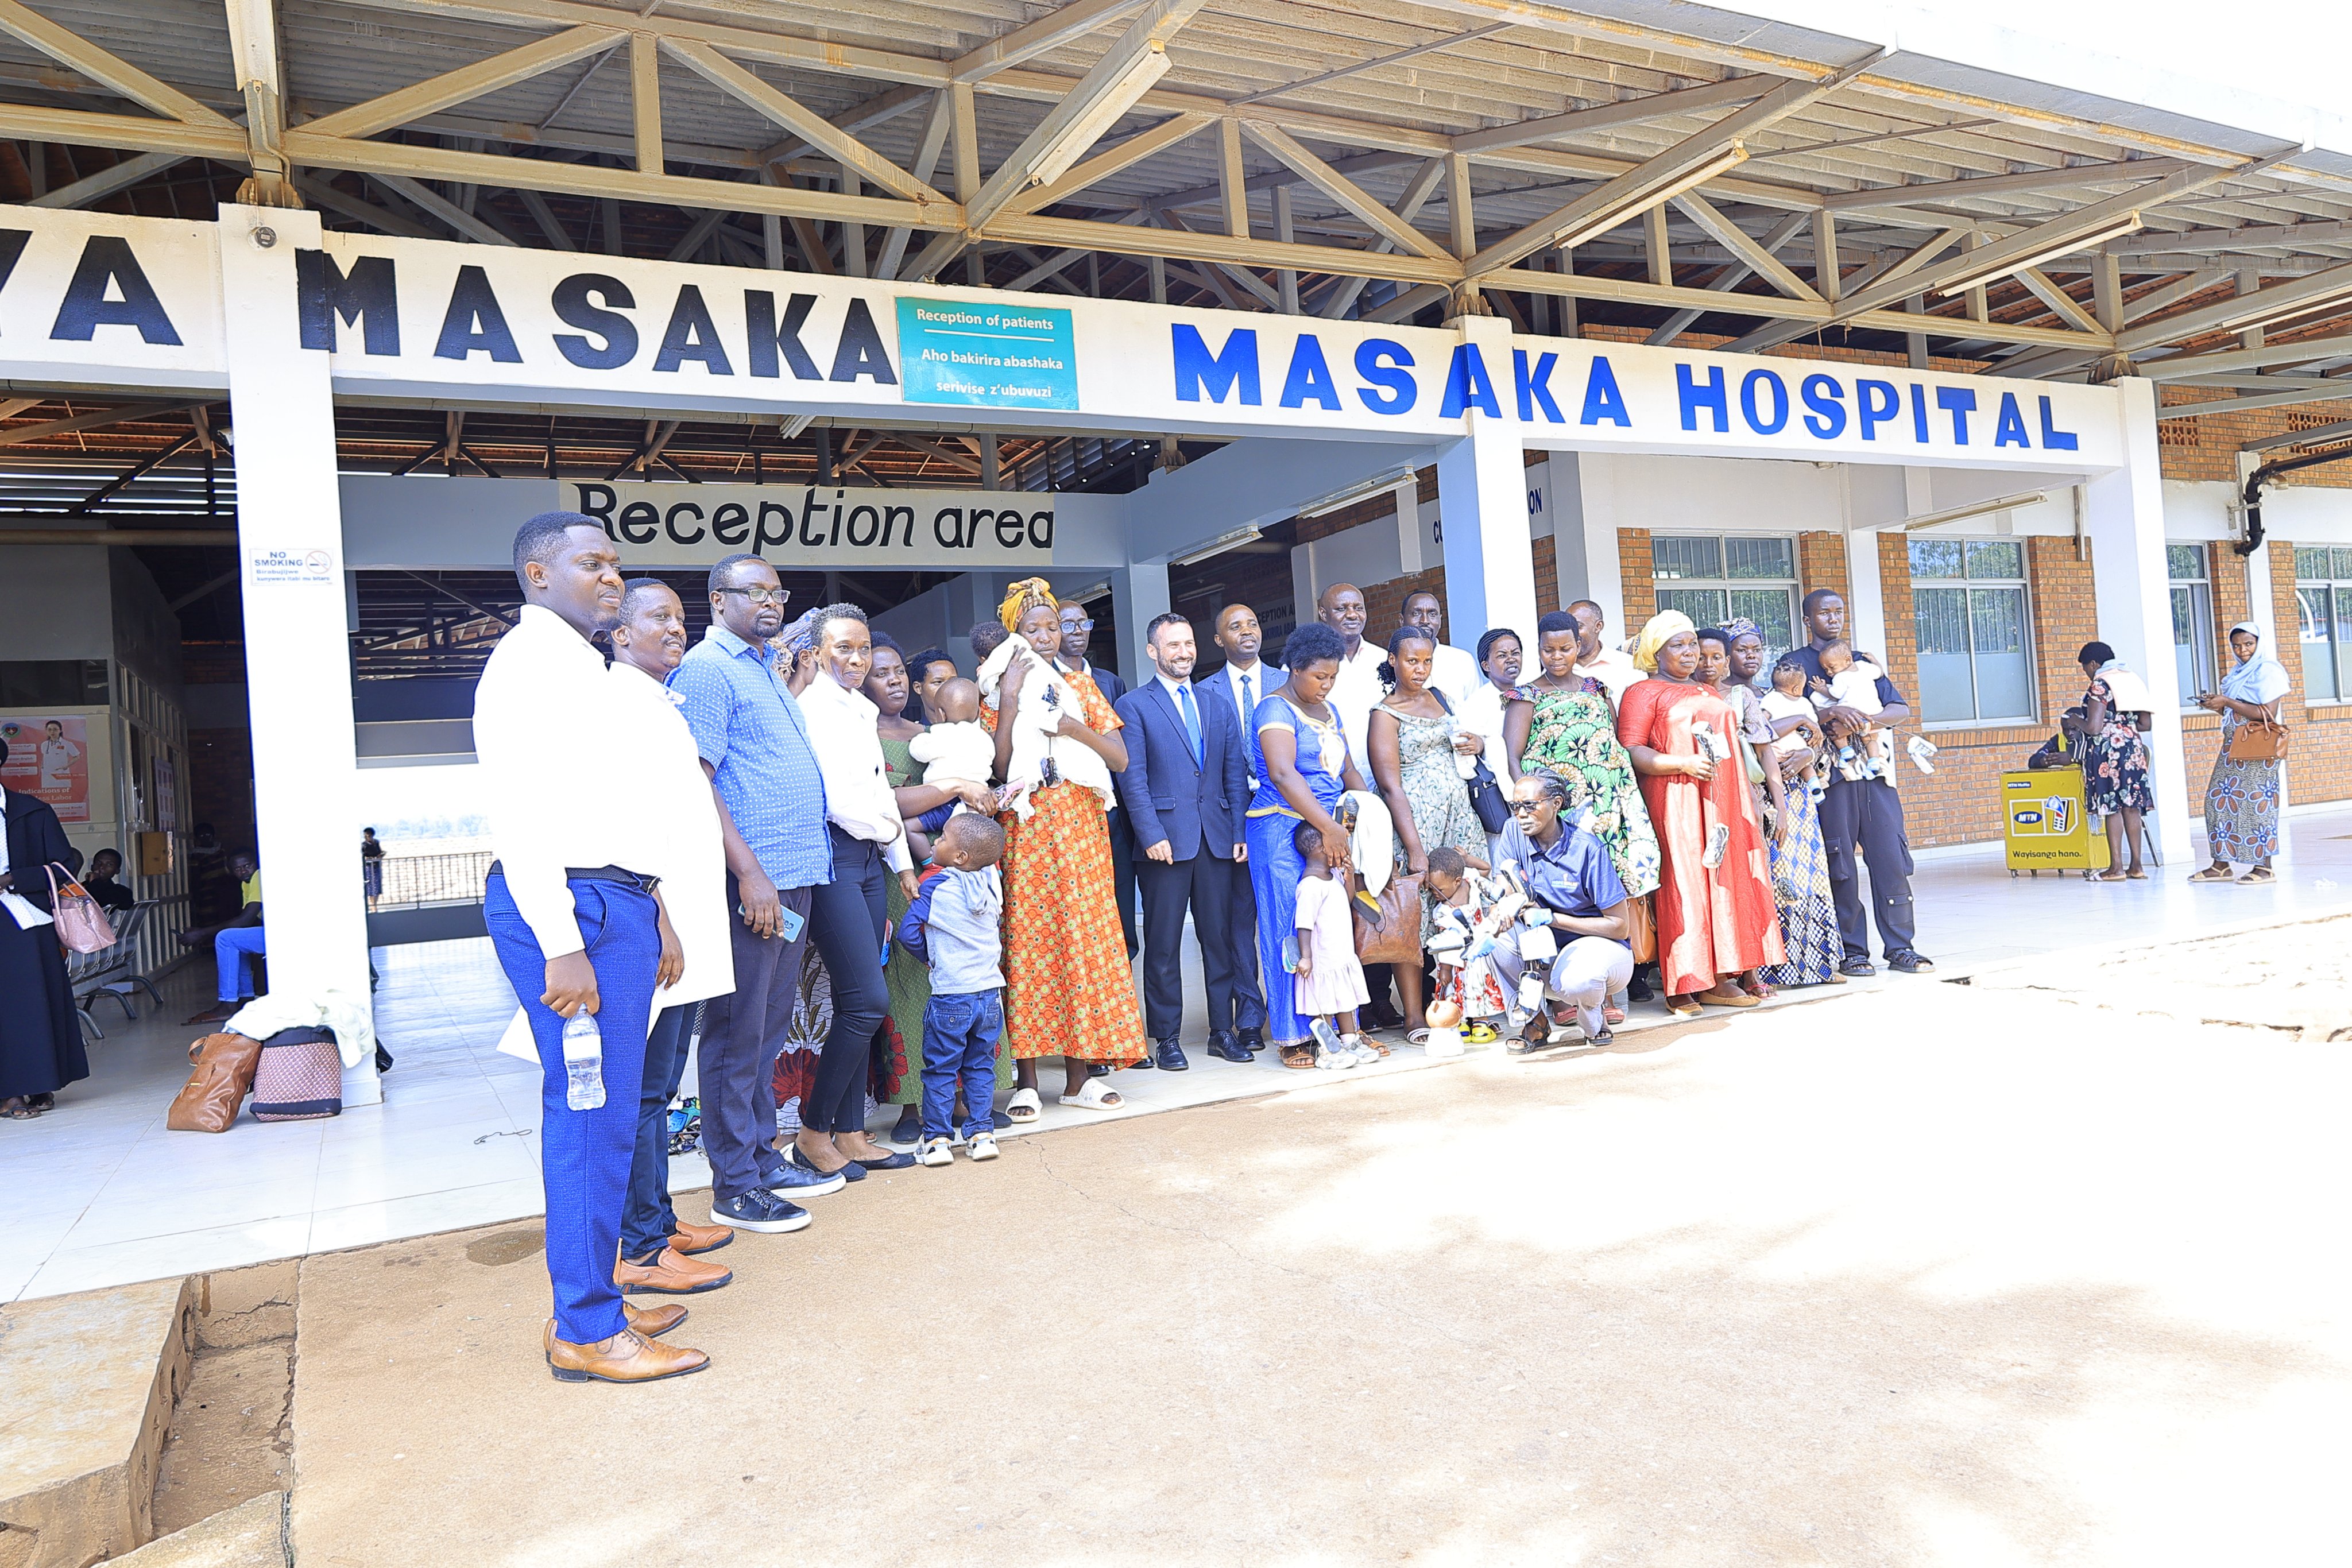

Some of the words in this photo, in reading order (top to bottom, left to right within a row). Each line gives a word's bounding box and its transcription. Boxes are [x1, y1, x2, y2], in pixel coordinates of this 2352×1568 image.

[295, 247, 898, 385] MASAKA
[916, 308, 982, 325] Reception
[986, 315, 1000, 326] of
[1003, 317, 1054, 330] patients
[921, 348, 949, 362] Aho
[951, 350, 1001, 366] bakirira
[1004, 355, 1063, 369] abashaka
[1171, 323, 1632, 428] MASAKA
[936, 381, 985, 395] serivise
[1675, 363, 2079, 451] HOSPITAL
[571, 483, 914, 556] Reception
[933, 505, 1054, 549] area
[1258, 605, 1287, 624] CEPTION
[2018, 813, 2037, 822] MTN
[2012, 850, 2057, 859] Wayisanga
